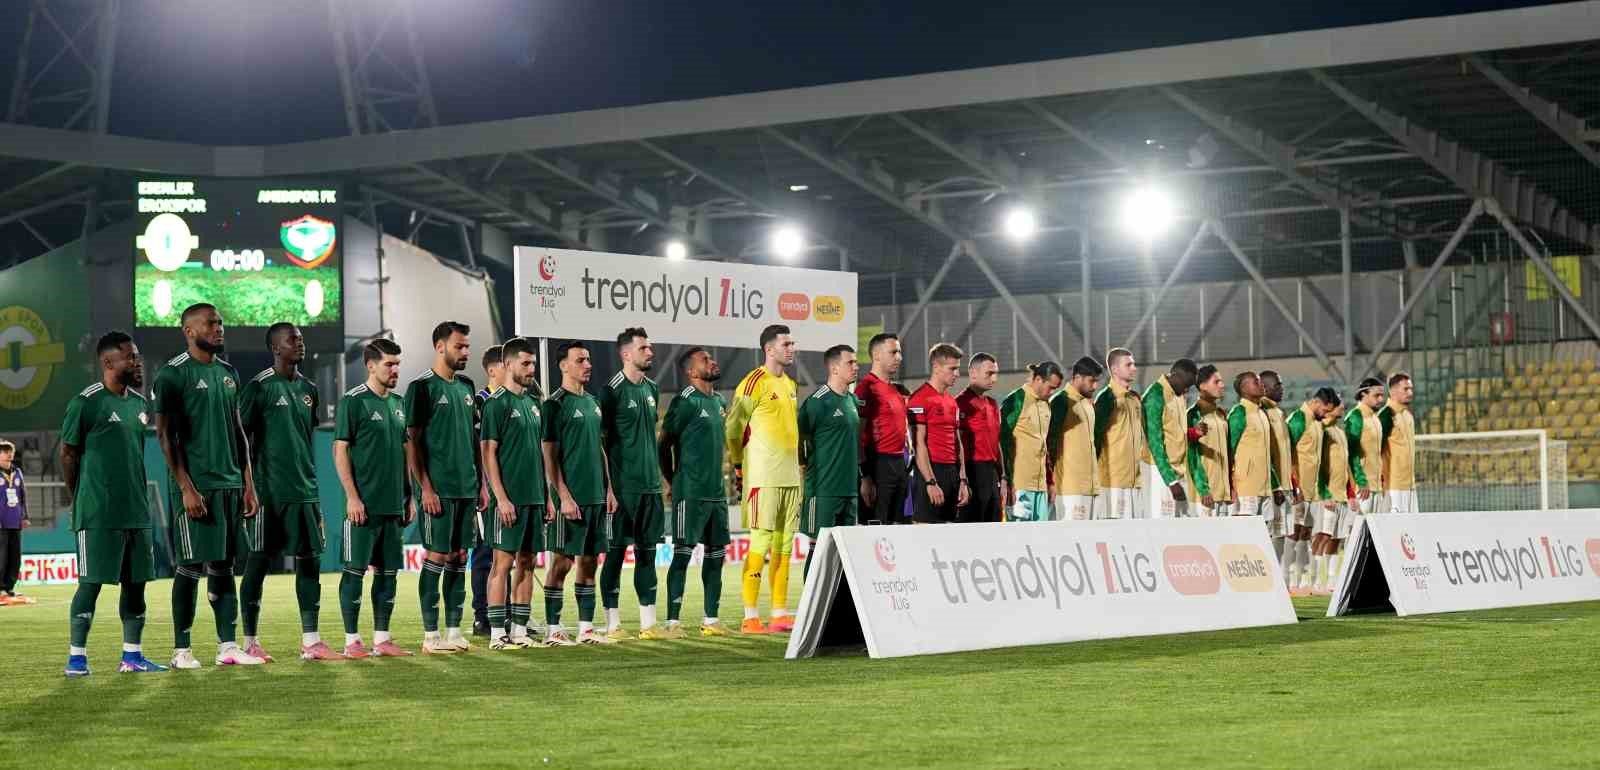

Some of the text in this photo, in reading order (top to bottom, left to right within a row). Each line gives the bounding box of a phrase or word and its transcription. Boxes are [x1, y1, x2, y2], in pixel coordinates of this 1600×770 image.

[210, 249, 265, 272] 00:00
[530, 282, 566, 298] trendyol
[581, 267, 709, 323] trendyol
[781, 301, 808, 313] trendyol
[1168, 559, 1216, 580] trendyol
[1226, 553, 1267, 577] NESİNE
[1436, 537, 1544, 590] trendyol
[872, 577, 918, 595] trendyol
[931, 542, 1095, 609] trendyol
